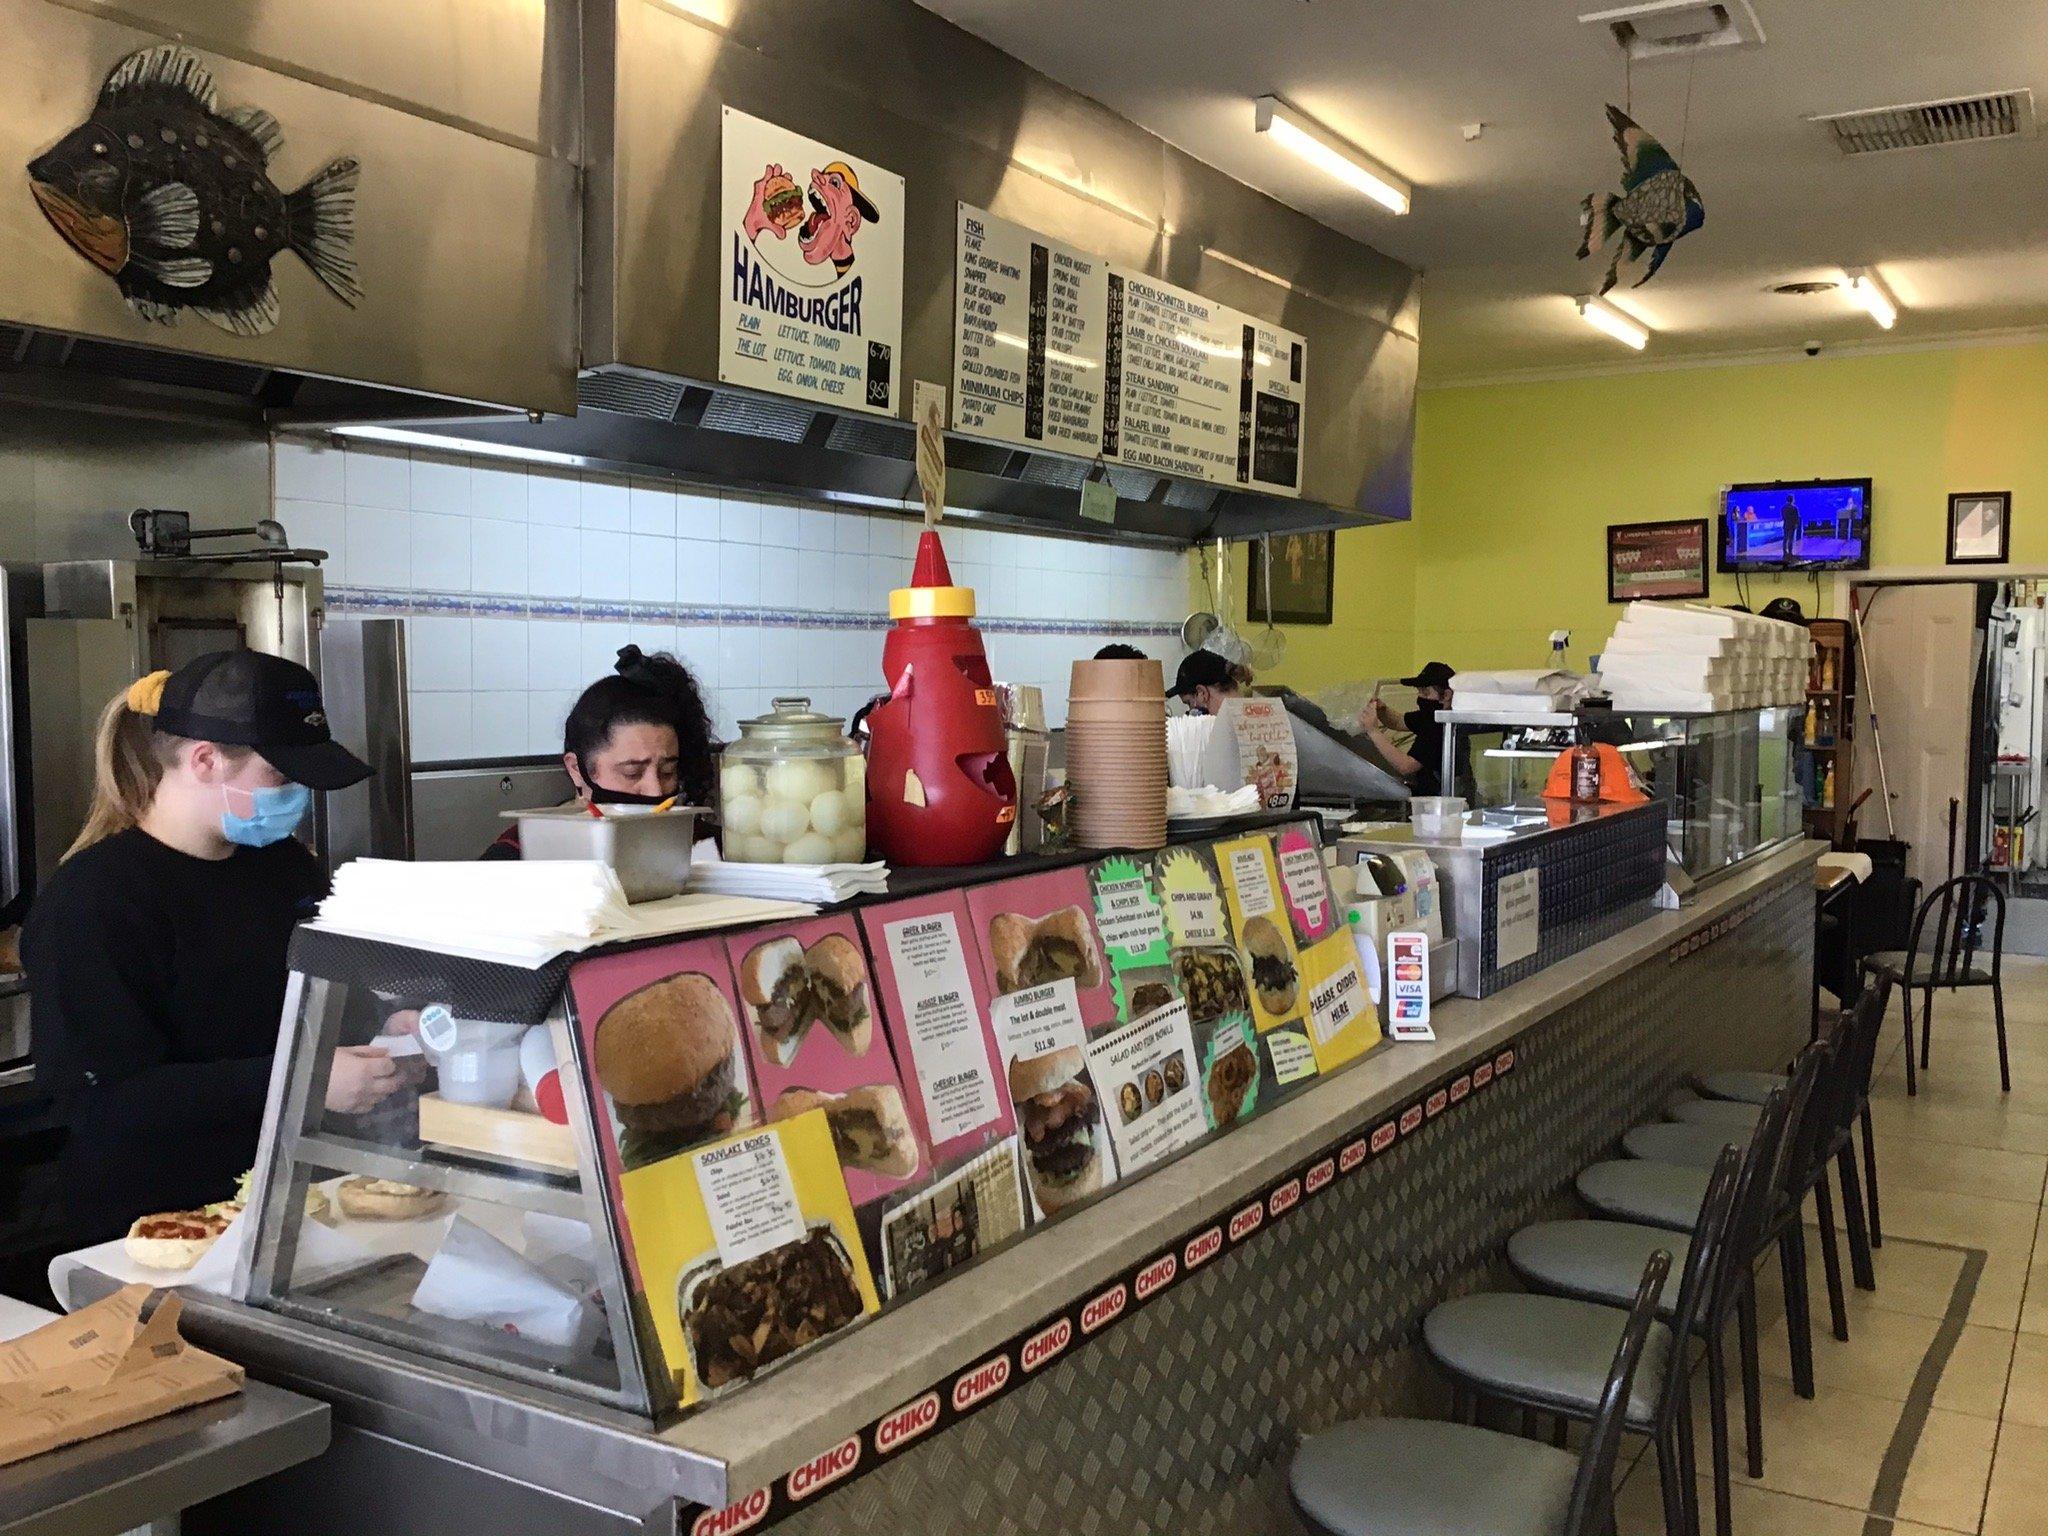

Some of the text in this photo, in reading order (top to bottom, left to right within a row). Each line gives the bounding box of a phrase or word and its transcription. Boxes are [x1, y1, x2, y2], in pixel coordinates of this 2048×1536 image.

[966, 218, 984, 236] FISH
[733, 230, 862, 336] HAMBURGER
[1128, 280, 1156, 299] CHICKEN
[1157, 290, 1186, 310] SCHNITZEL
[1187, 302, 1209, 319] BURGER
[739, 313, 840, 351] PLAIN LETTUCE, TOMATO
[963, 329, 983, 344] BUTTER
[1126, 325, 1145, 339] LAMB
[1155, 334, 1180, 351] CHICKEN
[737, 338, 751, 353] THE
[752, 343, 767, 357] LOT
[774, 348, 806, 367] LETTUCE,
[962, 360, 983, 375] GRILLED
[821, 379, 846, 395] CHEESE
[961, 379, 1024, 404] MINIMUM CHIPS
[1125, 371, 1146, 386] STEAK
[1147, 377, 1179, 395] SANDWICH
[982, 402, 996, 416] CAKE
[1124, 416, 1171, 436] FALAFEL WRAP
[1123, 448, 1137, 461] EGG
[1139, 452, 1152, 464] AND
[1153, 454, 1174, 469] BACON
[1174, 458, 1205, 475] SANDWICH
[1100, 882, 1119, 893] CHICKEN
[1171, 893, 1186, 902] CHIPS
[902, 921, 943, 937] GREEK BURGER
[917, 991, 960, 1009] AUSSIE BURGER
[1014, 987, 1055, 1005] JUMBO BURGER
[1310, 970, 1357, 1011] PLEASE ORDER
[1399, 984, 1422, 993] VISA
[1010, 1002, 1067, 1025] The lot & double meat
[1331, 1001, 1350, 1022] HERE
[1110, 1048, 1131, 1066] SALAD
[1131, 1042, 1143, 1057] AND
[1155, 1024, 1174, 1042] BOWLS
[932, 1069, 979, 1090] CHEESEY BURGER
[701, 1134, 771, 1164] SOUVLAKI BOXES
[1373, 1126, 1395, 1149] CHIKO
[1341, 1142, 1365, 1168] CHIKO
[1307, 1161, 1334, 1188] CHIKO
[1271, 1182, 1299, 1211] CHIKO
[1231, 1205, 1262, 1236] CHIKO
[1187, 1231, 1221, 1264] CHIKO
[1137, 1258, 1175, 1294] CHIKO
[1083, 1289, 1125, 1329] CHIKO
[1024, 1322, 1069, 1365] CHIKO
[956, 1360, 1008, 1405] CHIKO
[879, 1398, 937, 1446] CHIKO
[792, 1440, 858, 1494] CHIKO
[696, 1488, 765, 1536] CHIKO
